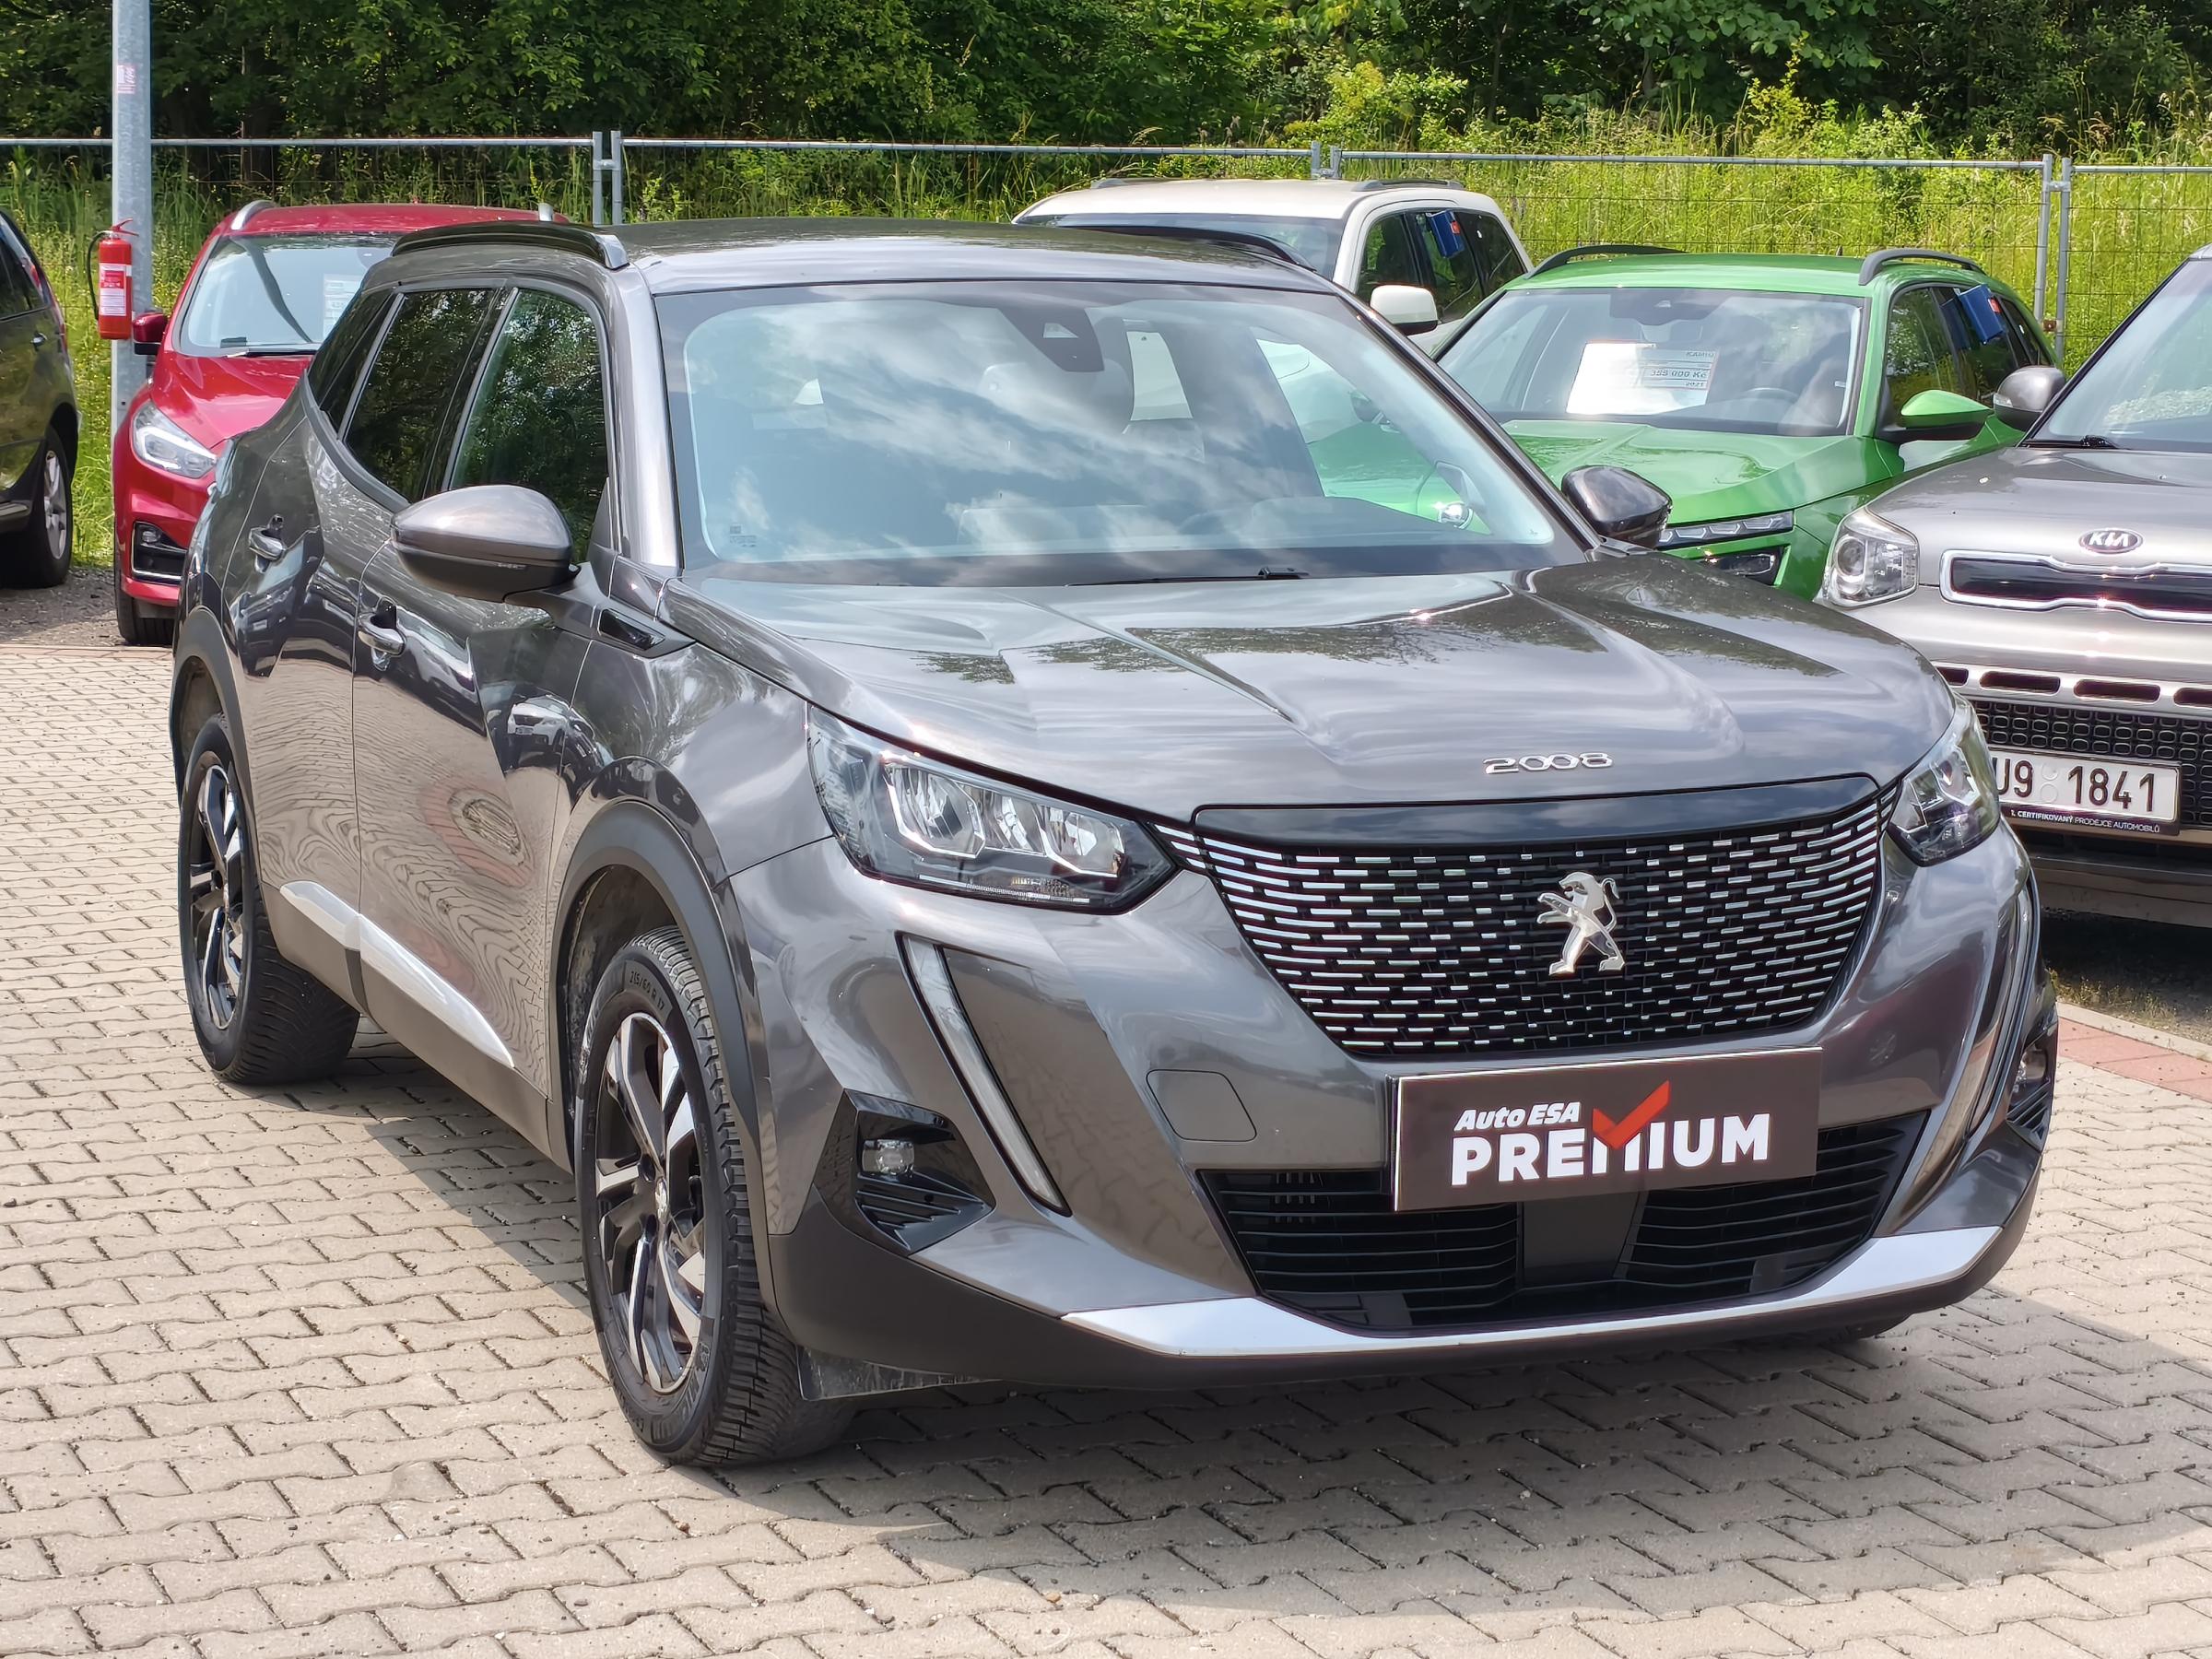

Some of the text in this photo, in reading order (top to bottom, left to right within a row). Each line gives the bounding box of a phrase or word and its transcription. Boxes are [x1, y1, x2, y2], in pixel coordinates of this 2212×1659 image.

[2088, 531, 2129, 547] KIA
[1483, 752, 1613, 774] 2008
[2067, 765, 2155, 812] 1841
[2075, 817, 2112, 828] PRODEJCE
[1453, 1101, 1582, 1132] Auto ESA
[1451, 1112, 1771, 1186] PREMIUM
